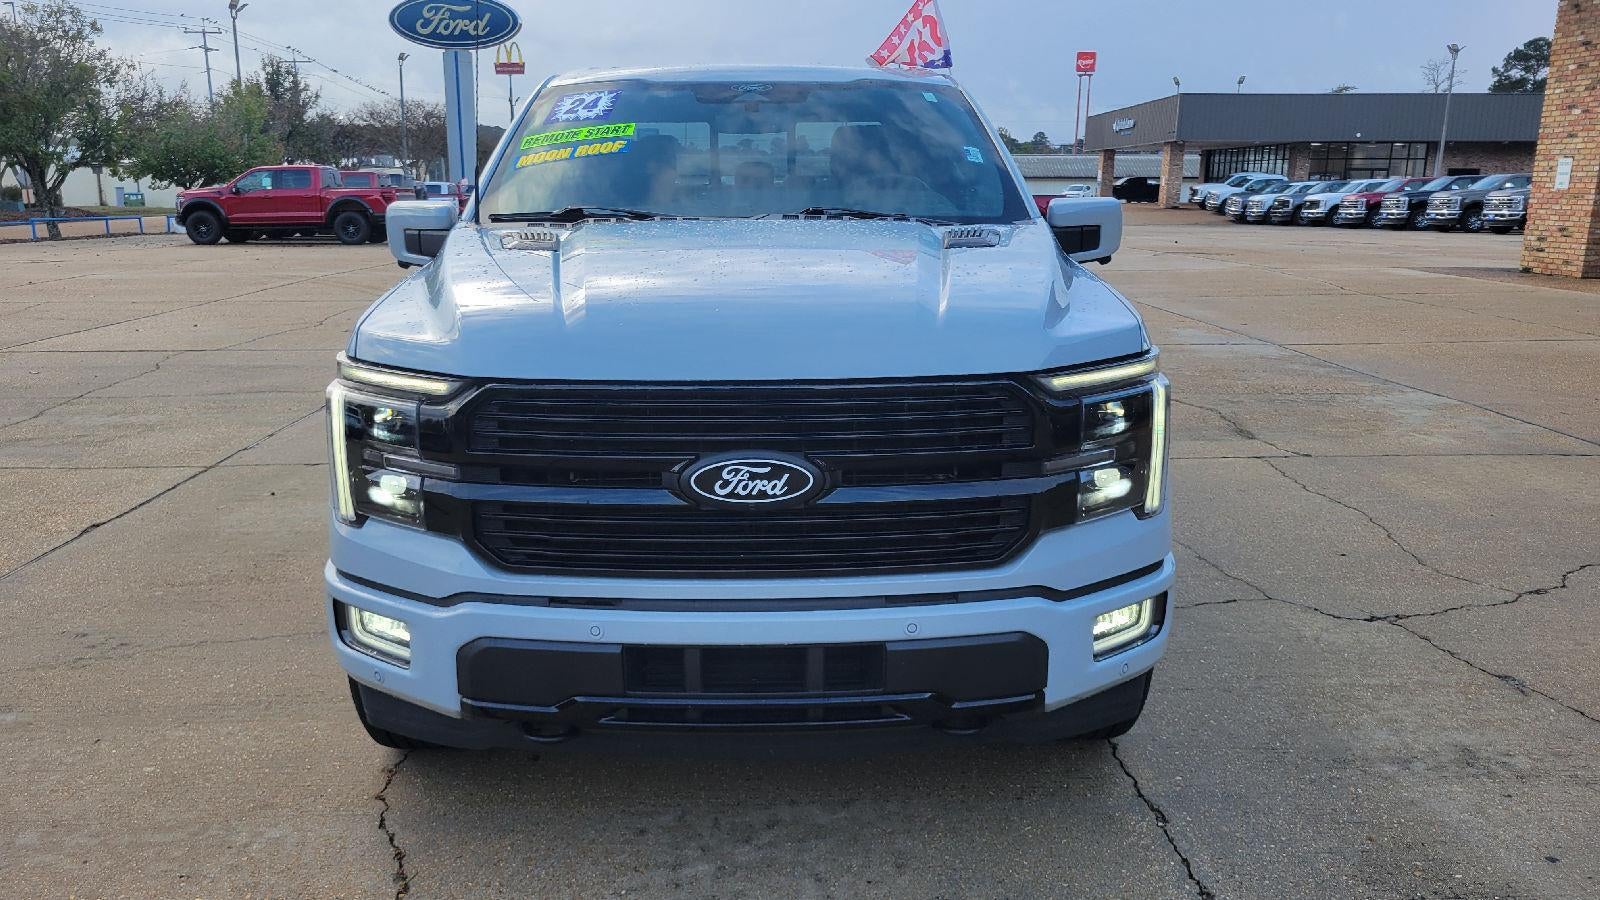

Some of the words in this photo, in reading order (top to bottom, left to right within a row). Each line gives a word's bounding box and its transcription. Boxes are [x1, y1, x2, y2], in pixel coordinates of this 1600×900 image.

[416, 3, 491, 36] Ford
[562, 95, 603, 116] 24
[525, 130, 581, 147] REMOTE
[586, 125, 630, 137] START
[517, 148, 572, 168] MOON
[576, 141, 626, 157] ROOF
[714, 465, 790, 496] Ford
